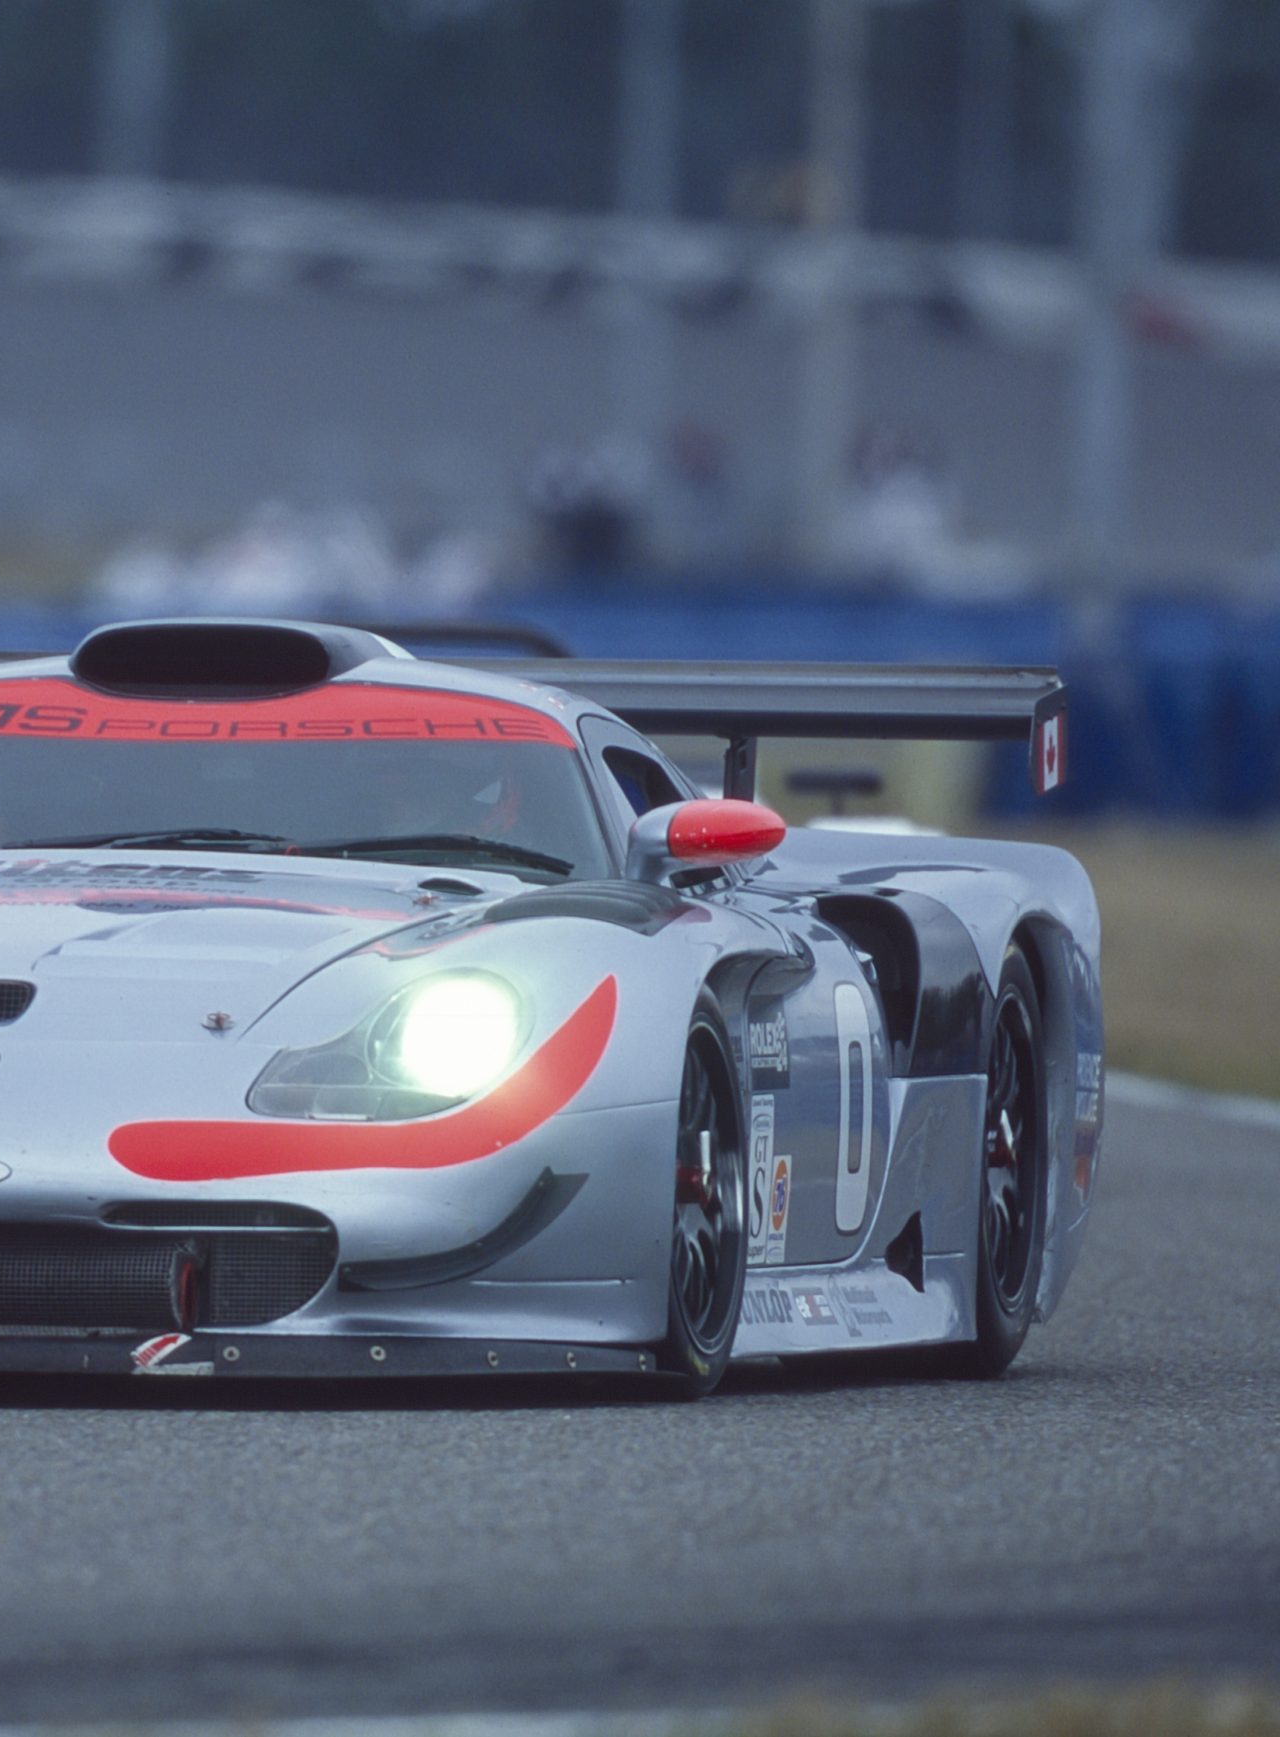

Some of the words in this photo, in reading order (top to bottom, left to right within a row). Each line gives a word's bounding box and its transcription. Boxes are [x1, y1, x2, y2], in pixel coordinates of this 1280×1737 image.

[94, 717, 549, 740] PORSCHE
[749, 1022, 780, 1055] ROLEX
[754, 1135, 769, 1163] GT
[750, 1166, 766, 1239] S
[748, 1245, 765, 1260] uper
[738, 1287, 794, 1326] UNLOP
